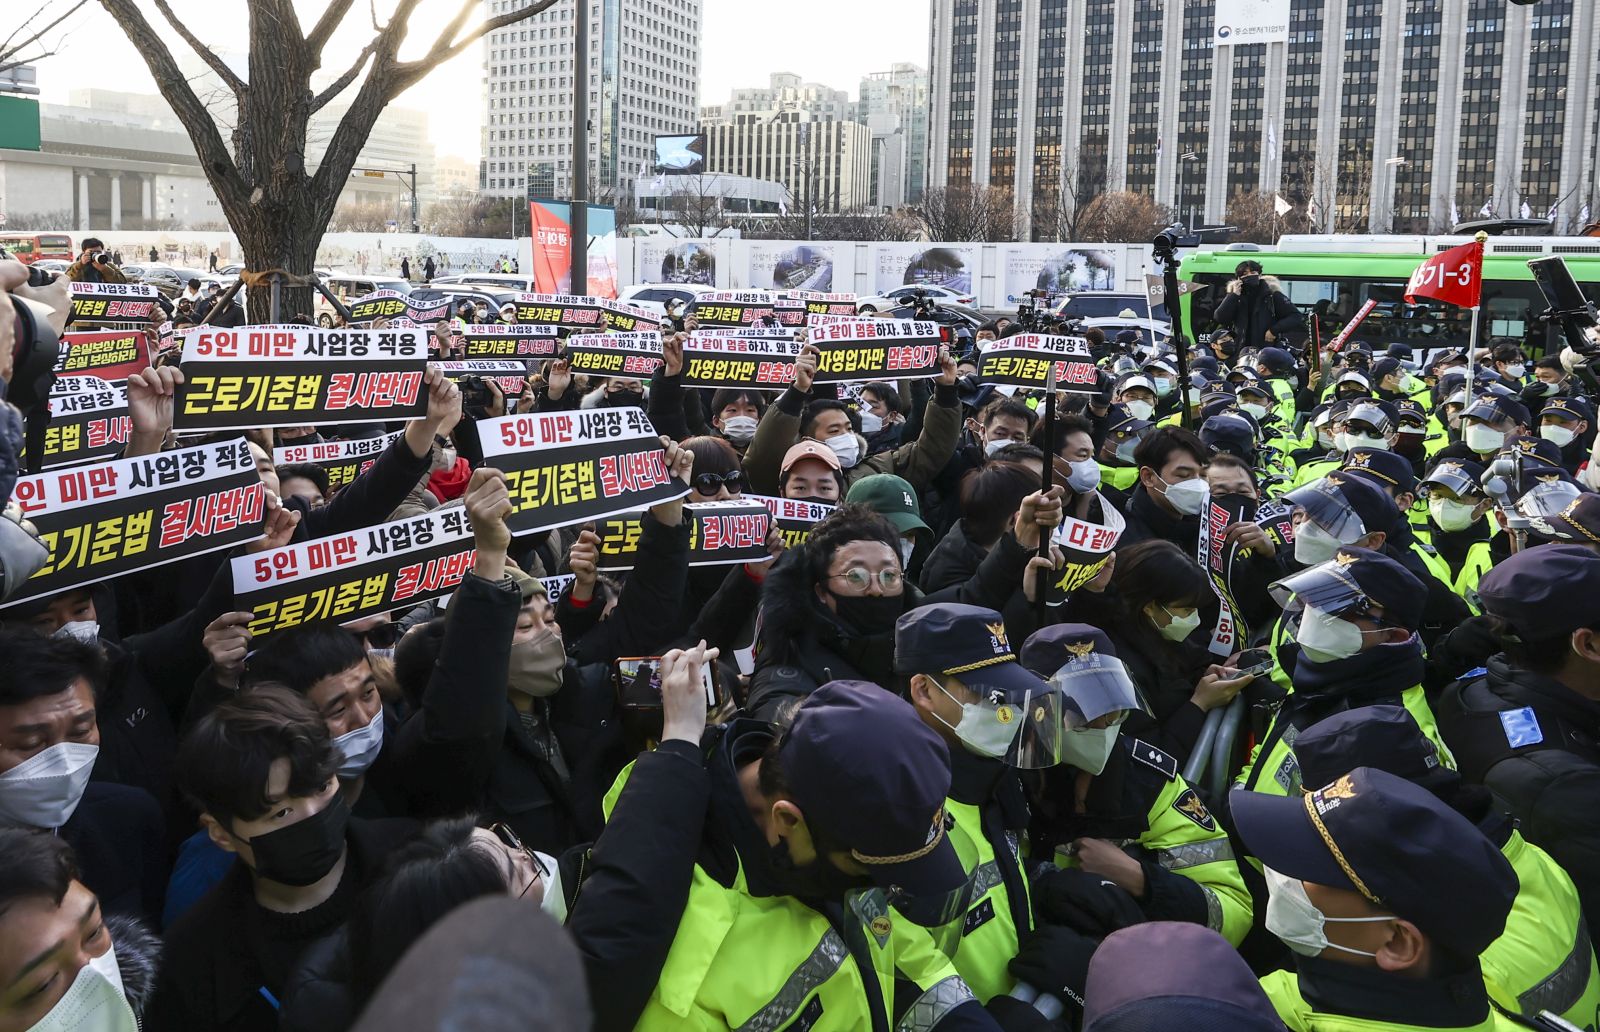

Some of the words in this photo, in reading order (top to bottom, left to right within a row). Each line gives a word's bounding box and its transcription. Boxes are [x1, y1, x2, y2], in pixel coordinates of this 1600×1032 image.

[1235, 25, 1285, 35] 중소벤처기업부
[72, 283, 94, 293] 미만
[97, 284, 128, 295] 사업장
[131, 285, 150, 296] 적용
[536, 294, 552, 302] 미만
[555, 295, 578, 304] 사업장
[581, 296, 596, 304] 적용
[716, 293, 732, 302] 미만
[735, 294, 758, 303] 사업장
[106, 300, 153, 318] 결사반대
[352, 301, 407, 318] 근로기준법
[406, 305, 449, 321] 결사반대
[517, 307, 561, 321] 근로기준법
[562, 309, 598, 323] 결사반대
[696, 306, 741, 321] 근로기준법
[807, 303, 828, 314] 약속을
[471, 326, 486, 334] 5인
[488, 326, 505, 334] 미만
[614, 316, 635, 330] 약속을
[813, 327, 825, 341] 다
[829, 324, 852, 339] 같이
[855, 322, 900, 338] 멈춤하자.
[901, 323, 912, 336] 왜
[914, 322, 934, 336] 항상
[69, 341, 115, 357] 손실보상
[196, 332, 239, 357] 5인
[248, 332, 297, 357] 미만
[303, 332, 371, 357] 사업장
[377, 332, 417, 357] 적용
[467, 340, 516, 354] 근로기준법
[516, 340, 555, 354] 결사반대
[580, 339, 598, 347] 같이
[601, 338, 637, 350] 멈춤하자.
[639, 341, 647, 350] 왜
[687, 337, 698, 349] 다
[702, 337, 722, 351] 같이
[726, 338, 773, 352] 멈춤하자.
[775, 342, 787, 353] 왜
[991, 338, 1010, 350] 5인
[1014, 335, 1040, 349] 미만
[1043, 337, 1076, 353] 사업장
[1078, 338, 1091, 354] 적
[65, 356, 89, 370] 손실
[89, 348, 137, 367] 보상하라!
[467, 362, 497, 370] 사업장
[499, 362, 518, 370] 적용
[571, 352, 623, 371] 자영업자만
[816, 347, 884, 373] 자영업자만
[887, 345, 938, 370] 멈춤인가
[687, 358, 756, 381] 자영업자만
[981, 357, 1051, 381] 근로기준법
[60, 390, 114, 413] 사업장
[183, 374, 323, 415] 근로기준법
[324, 370, 424, 411] 결사반대
[500, 418, 535, 447] 5인
[539, 415, 573, 444] 미만
[578, 411, 622, 440] 사업장
[284, 447, 308, 462] 5인
[312, 444, 341, 460] 미만
[344, 438, 384, 456] 사업장
[14, 477, 47, 513] 인
[58, 466, 118, 504] 미만
[128, 449, 207, 490] 사업장
[504, 459, 597, 515] 근로기준법
[600, 449, 671, 499] 결사반대
[902, 491, 913, 507] LA
[158, 481, 266, 549] 결사반대
[702, 513, 769, 551] 결사반대
[1069, 522, 1089, 546] 다
[1090, 528, 1118, 550] 같이
[254, 549, 299, 583] 5인
[307, 536, 359, 571] 미만
[366, 518, 435, 557] 사업장
[247, 572, 390, 637] 근로기준법
[391, 549, 478, 603] 결사반
